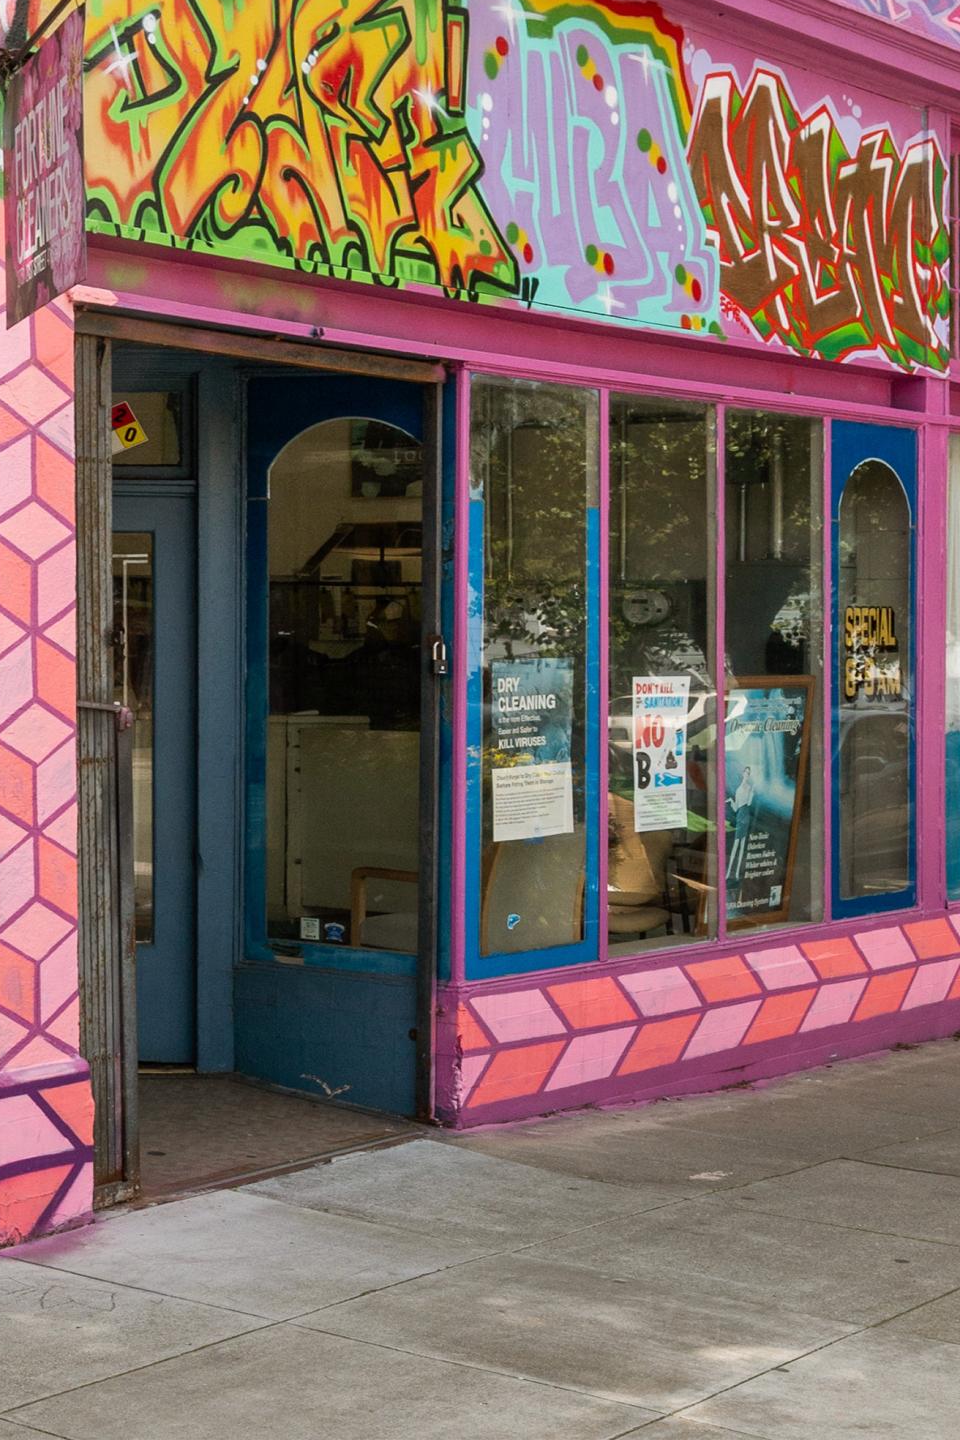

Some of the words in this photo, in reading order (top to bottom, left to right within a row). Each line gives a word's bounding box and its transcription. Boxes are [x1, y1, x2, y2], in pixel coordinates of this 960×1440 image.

[14, 75, 70, 195] FORTUNE
[16, 159, 73, 263] CLEANERS
[124, 427, 138, 443] 0
[844, 607, 898, 648] SPECIAL
[497, 677, 520, 693] DRY
[635, 683, 659, 695] DON'T
[498, 694, 557, 712] CLEANING
[635, 713, 665, 749] NO
[763, 715, 801, 736] Cleaning
[498, 738, 514, 750] KILL
[514, 735, 547, 748] VIRUSES
